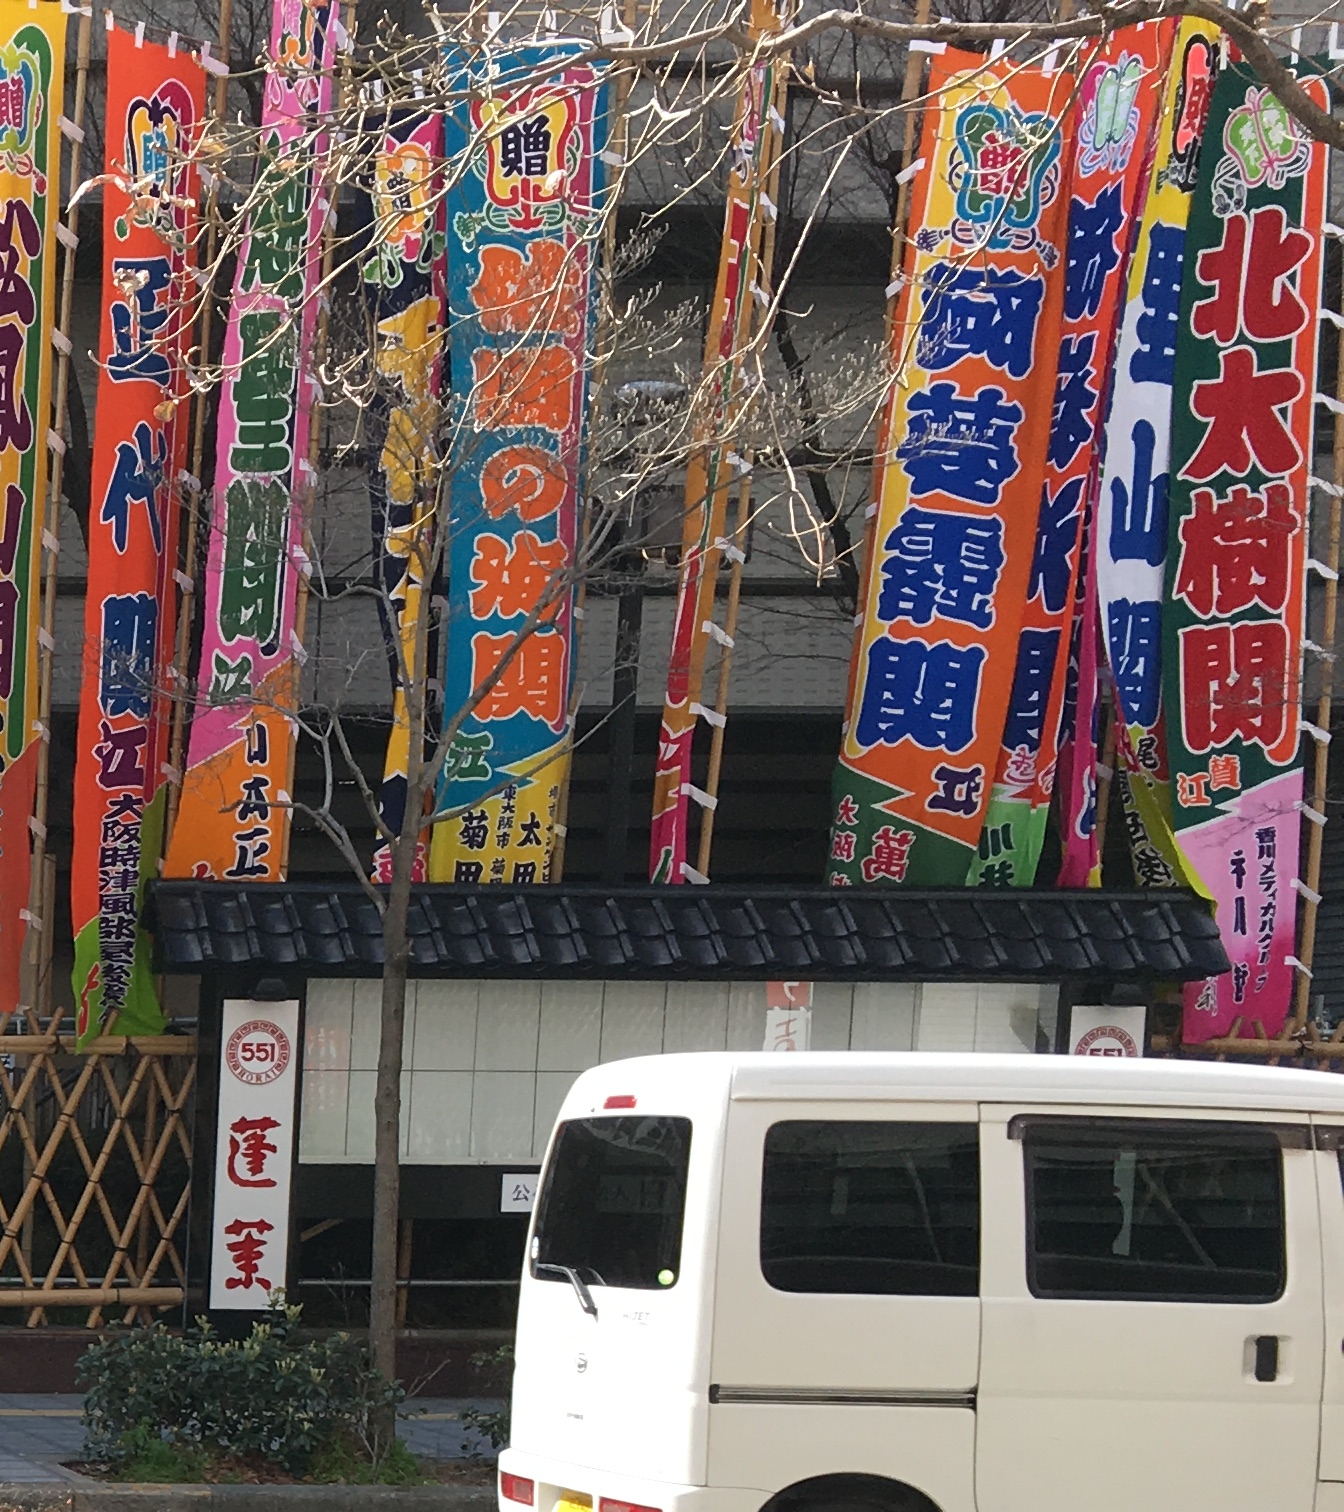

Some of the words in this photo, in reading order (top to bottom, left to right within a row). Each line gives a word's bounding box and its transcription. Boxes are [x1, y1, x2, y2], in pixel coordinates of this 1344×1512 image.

[500, 115, 551, 179] 贈
[1174, 206, 1315, 754] 北太樹関
[240, 1042, 276, 1063] 551
[236, 1067, 279, 1084] HORAI
